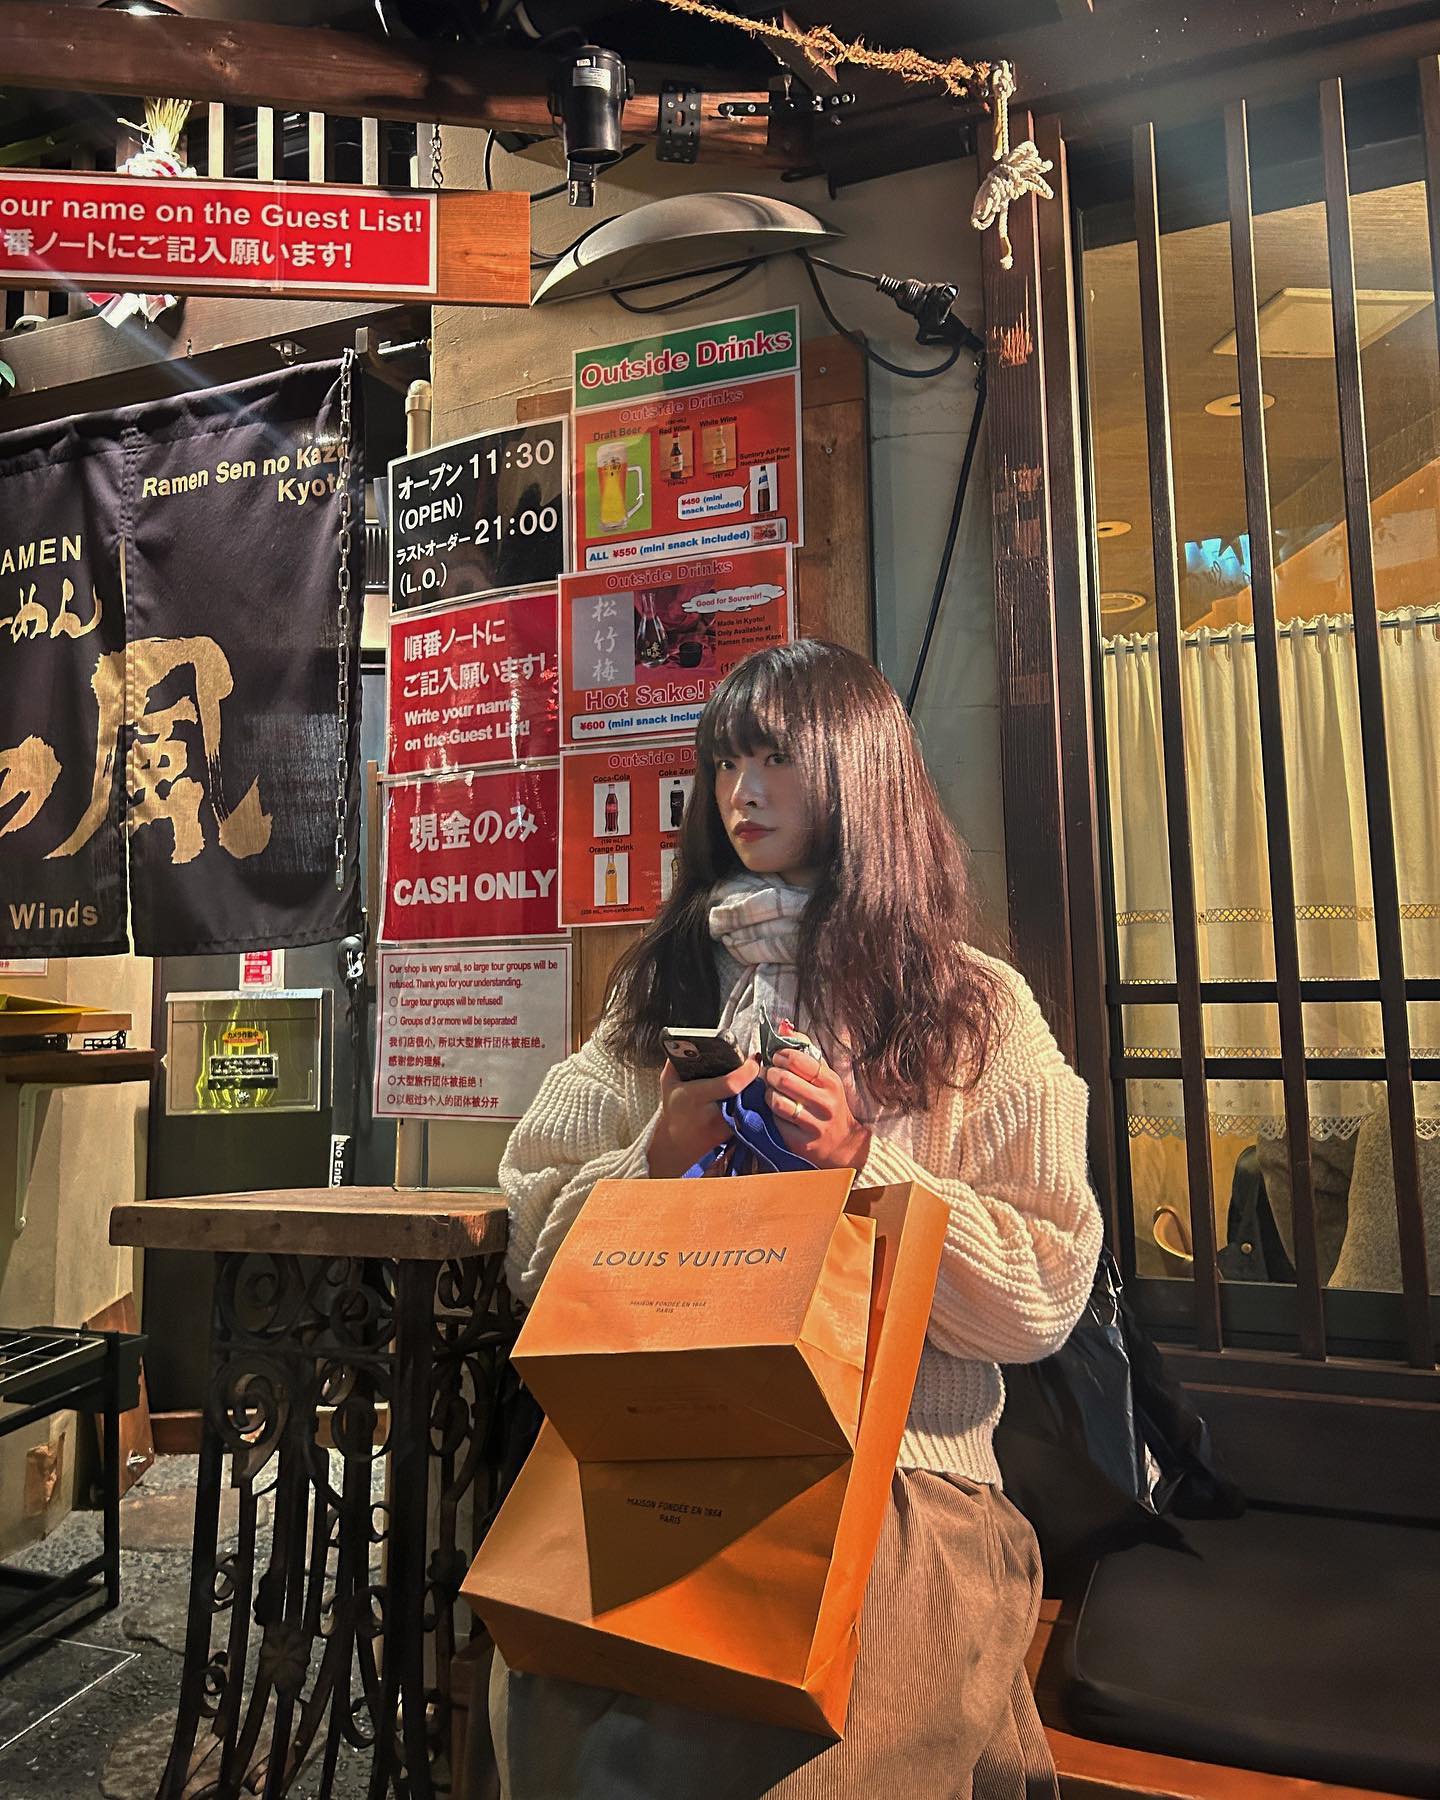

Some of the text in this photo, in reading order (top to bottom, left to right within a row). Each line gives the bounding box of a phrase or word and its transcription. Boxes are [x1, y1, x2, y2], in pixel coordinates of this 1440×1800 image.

[1, 198, 422, 233] our name on the Guest List!
[581, 330, 792, 389] Outside Drinks
[619, 389, 744, 423] Outside Drinks
[593, 426, 641, 441] Draft Beer
[469, 440, 554, 479] 11:30
[142, 470, 208, 498] Ramen
[215, 460, 255, 483] Sen
[262, 455, 290, 475] no
[398, 462, 463, 500] オープン
[399, 493, 463, 534] (OPEN)
[682, 499, 742, 515] snack included)
[703, 494, 723, 503] (mini
[475, 507, 558, 545] 21:00
[396, 533, 471, 565] ラストオーダー
[590, 530, 750, 561] ALL ¥550 (mini snack included)
[400, 562, 447, 597] (L.O.)
[607, 560, 733, 589] Outside Drinks
[696, 593, 762, 607] Good for Souvenir!
[404, 620, 506, 662] 順番ノートに
[592, 598, 619, 682] 松竹梅
[403, 652, 545, 698] ご記入願います!
[585, 687, 629, 711] Hot
[636, 680, 705, 706] Sake!
[405, 709, 440, 727] Write
[442, 703, 474, 724] your
[580, 721, 605, 731] ¥600
[608, 717, 633, 730] (mini
[636, 715, 667, 725] snack
[405, 720, 530, 751] on the Guest Lit!
[608, 751, 675, 769] Outside
[593, 774, 630, 783] Coca-Cola
[410, 804, 538, 853] 現金のみ
[589, 846, 614, 854] Orange
[615, 844, 634, 852] Drink
[393, 869, 557, 907] CASH ONLY
[9, 901, 99, 930] Winds
[389, 965, 402, 973] Our
[405, 965, 420, 975] shop
[429, 965, 442, 975] very
[473, 962, 489, 973] large
[491, 962, 504, 971] tour
[506, 962, 531, 973] groups
[533, 960, 546, 970] will
[548, 960, 558, 969] be
[389, 977, 522, 990] refused. Thank you for your understanding.
[401, 997, 418, 1008] Large
[420, 997, 432, 1006] tour
[434, 998, 455, 1008] groups
[457, 996, 466, 1005] will
[467, 996, 476, 1005] be
[400, 1016, 423, 1027] Groups
[425, 1016, 431, 1025] of
[432, 1016, 435, 1025] 3
[437, 1017, 443, 1025] or
[445, 1016, 461, 1025] more
[462, 1016, 472, 1025] will
[474, 1016, 482, 1025] be
[335, 1141, 345, 1158] No
[593, 1247, 787, 1267] LOUIS VUITTON
